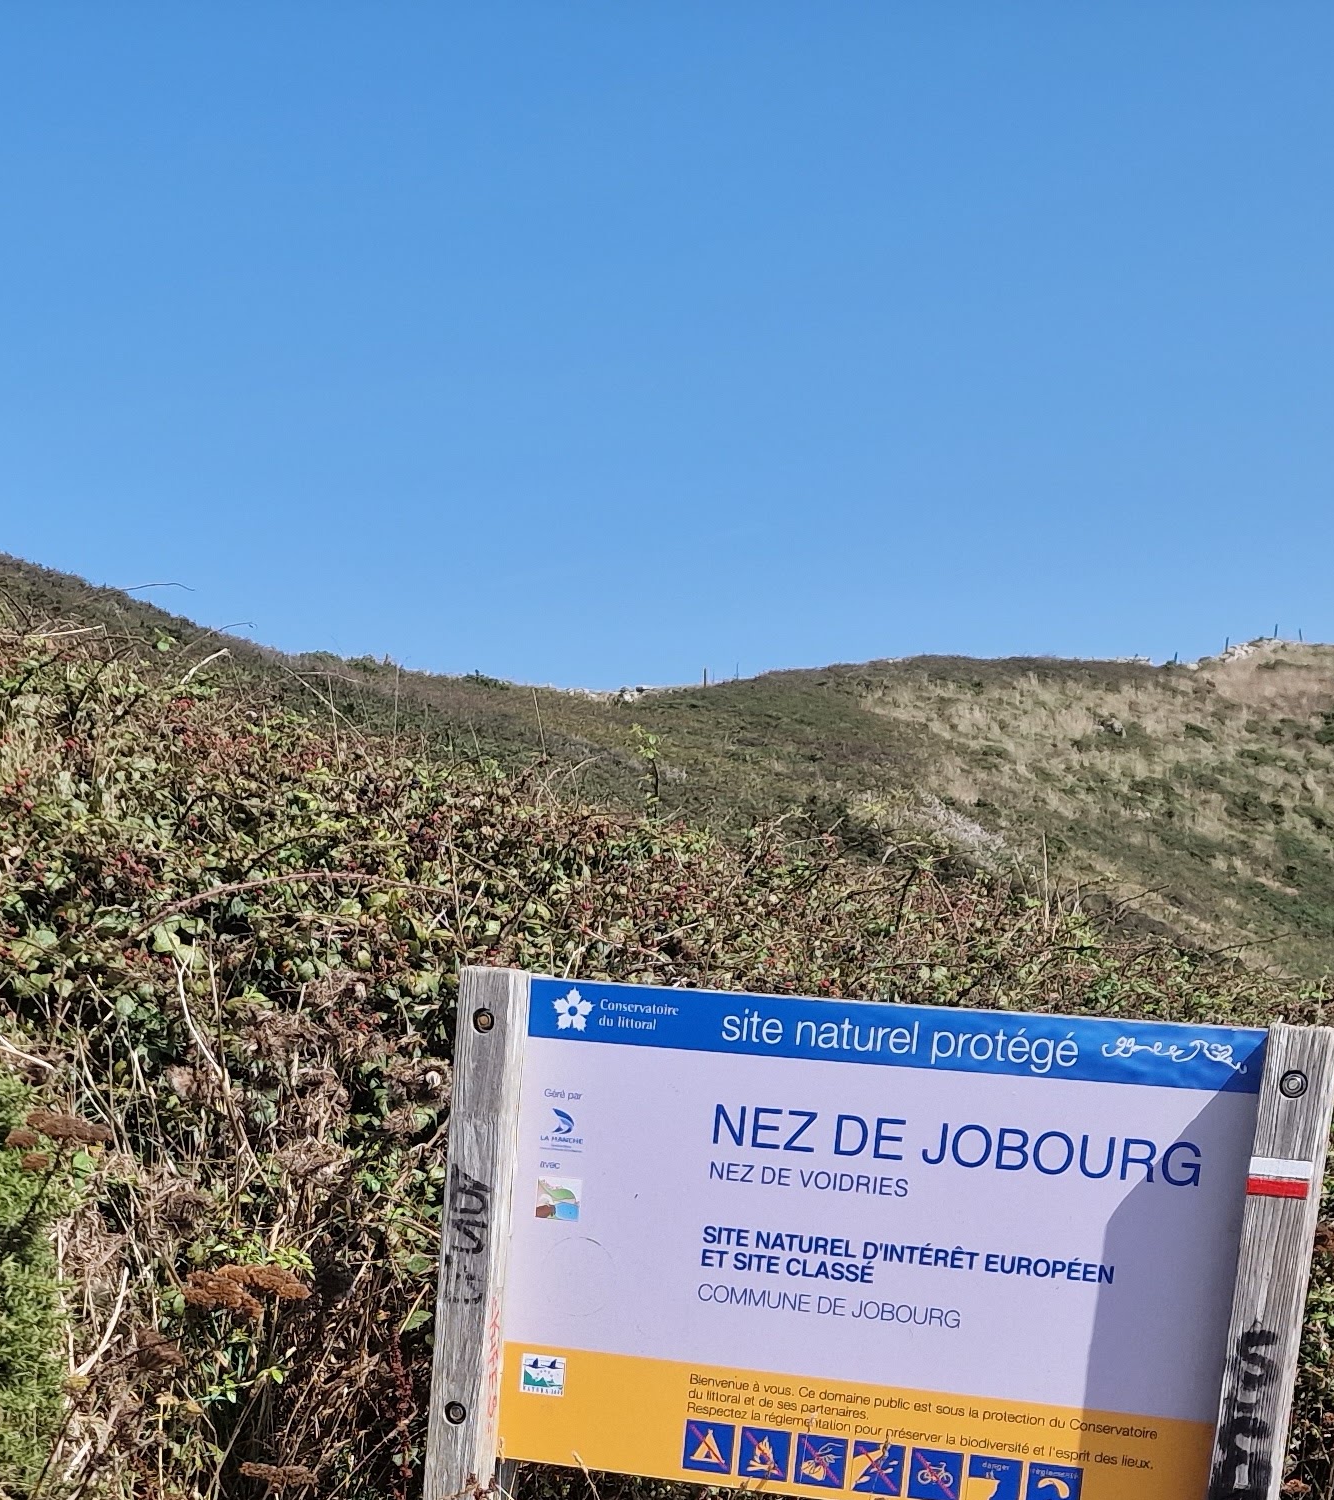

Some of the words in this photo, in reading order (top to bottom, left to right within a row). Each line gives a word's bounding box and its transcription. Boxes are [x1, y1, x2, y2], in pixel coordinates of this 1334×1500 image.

[598, 1014, 614, 1027] du
[617, 1016, 657, 1031] littoral
[600, 998, 679, 1016] Conservatoire
[721, 1008, 783, 1045] site
[795, 1017, 919, 1056] naturel
[930, 1027, 1079, 1074] protégé
[567, 1092, 583, 1101] par
[712, 1103, 818, 1153] NEZ
[833, 1114, 907, 1161] DE
[921, 1122, 1202, 1187] JOBOURG
[709, 1161, 755, 1183] NEZ
[761, 1166, 792, 1187] DE
[800, 1169, 909, 1198] VOIDRIES
[700, 1249, 729, 1269] ET
[733, 1252, 781, 1275] SITE
[785, 1258, 875, 1284] CLASSÉ
[702, 1225, 750, 1248] SITE
[755, 1230, 857, 1259] NATUREL
[862, 1241, 980, 1271] D'INTÉRÊT
[984, 1254, 1115, 1285] EUROPÉEN
[697, 1283, 812, 1313] COMMUNE
[817, 1295, 847, 1317] DE
[851, 1300, 961, 1329] JOBOURG
[688, 1388, 703, 1400] du
[706, 1390, 741, 1405] littoral
[743, 1395, 755, 1406] et
[758, 1397, 774, 1409] de
[776, 1400, 798, 1412] ses
[800, 1403, 869, 1421] partenaires.
[689, 1373, 750, 1391] Bienvenue
[752, 1381, 760, 1392] à
[763, 1384, 795, 1397] vous.
[798, 1386, 816, 1399] Ce
[819, 1389, 871, 1405] domaine
[873, 1396, 911, 1411] public
[913, 1402, 932, 1413] est
[935, 1404, 965, 1417] sous
[968, 1407, 980, 1419] la
[982, 1409, 1046, 1428] protection
[1048, 1416, 1066, 1430] du
[1069, 1418, 1158, 1441] Conservatoire
[686, 1402, 748, 1420] Respectez
[751, 1410, 761, 1421] la
[764, 1412, 851, 1433] réglementation
[854, 1423, 883, 1436] pour
[885, 1427, 943, 1443] préserver
[945, 1433, 956, 1445] la
[959, 1434, 1030, 1454] biodiversité
[1032, 1445, 1045, 1457] et
[1048, 1445, 1091, 1463] l'esprit
[1094, 1451, 1119, 1466] des
[1121, 1455, 1154, 1470] lieux.
[982, 1461, 1011, 1472] danger
